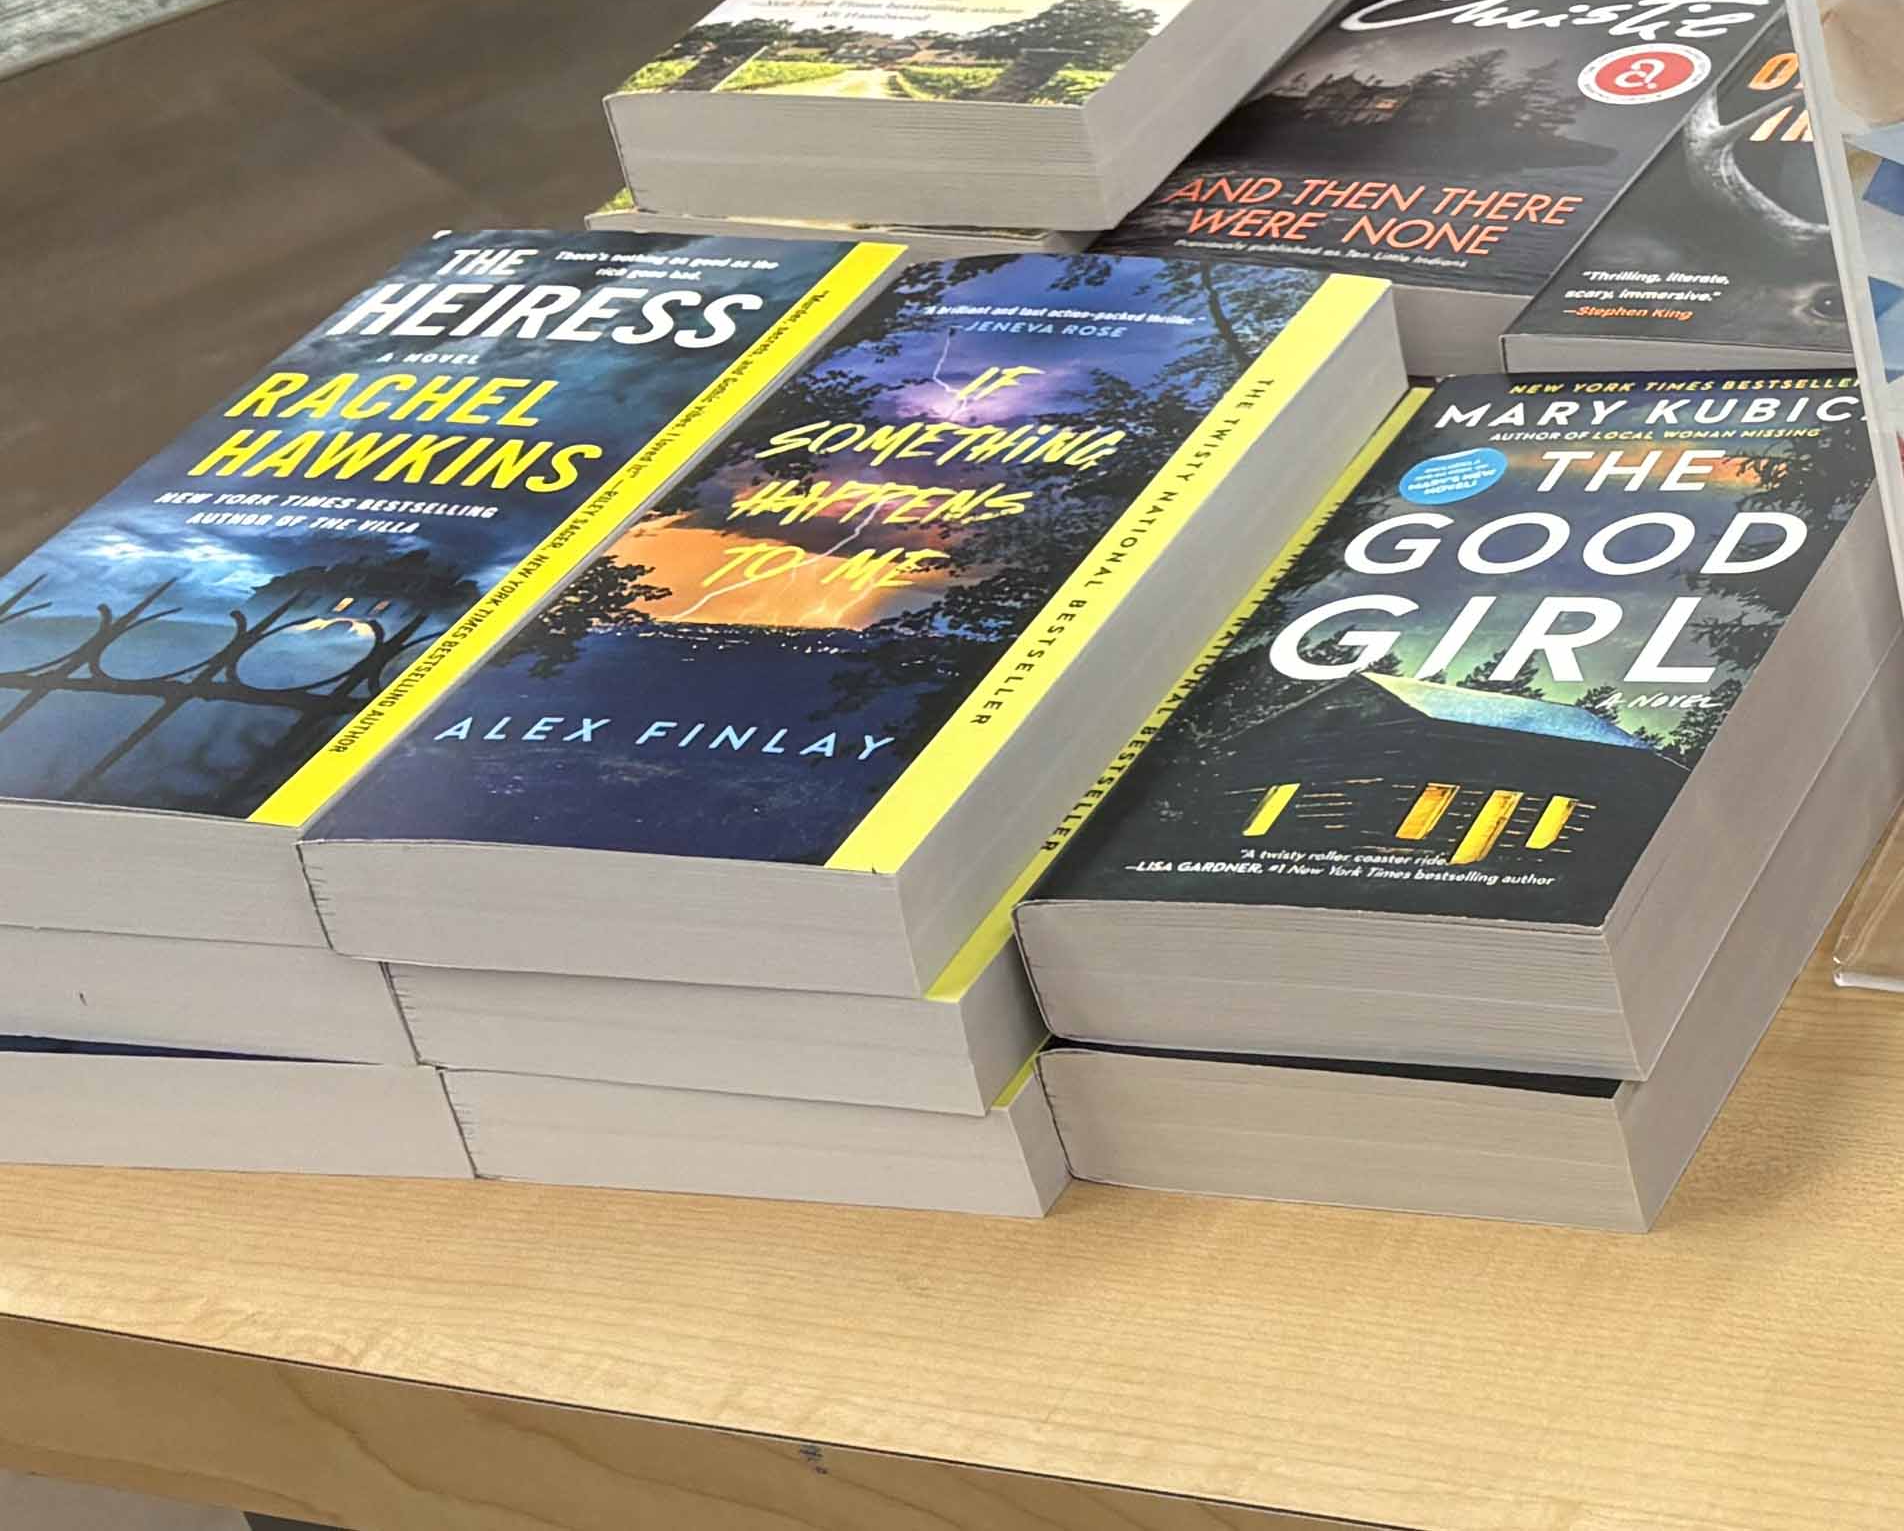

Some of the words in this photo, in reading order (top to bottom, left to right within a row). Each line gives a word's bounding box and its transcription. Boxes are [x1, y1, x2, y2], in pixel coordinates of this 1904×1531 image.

[1162, 177, 1283, 204] AND
[1290, 179, 1426, 212] THEN
[1432, 187, 1584, 226] THERE
[1187, 208, 1327, 240] WERE
[1341, 219, 1509, 255] NONE
[440, 249, 539, 277] THE
[325, 284, 763, 349] HEIRESS
[1062, 326, 1128, 338] ROSE
[1652, 308, 1693, 320] King
[377, 353, 395, 363] A
[404, 353, 481, 365] NOVEL
[224, 373, 559, 428] RACHEL
[957, 367, 1047, 401] IF
[1235, 378, 1275, 410] THE
[1510, 384, 1563, 394] NEW
[1573, 382, 1636, 393] YORK
[1644, 380, 1713, 392] TIMES
[1722, 377, 1861, 391] BESTSELLE
[1435, 400, 1629, 429] MARY
[1646, 395, 1868, 426] KUBIC
[755, 420, 1127, 471] SOMETHING
[1176, 418, 1241, 482] TWISTY
[1489, 430, 1571, 442] AUTHOR
[1573, 430, 1592, 441] OF
[1592, 429, 1655, 441] LOCAL
[1662, 429, 1735, 440] WOMAN
[1738, 427, 1822, 439] MISSING
[187, 430, 603, 493] HAWKINS
[1537, 450, 1727, 493] THE
[153, 491, 213, 504] NEW
[213, 493, 279, 506] YORK
[280, 495, 356, 510] TIMES
[355, 498, 499, 519] BESTSELLING
[727, 481, 1034, 526] HAPPENS
[186, 512, 273, 527] AUTHOR
[275, 515, 307, 528] OF
[309, 517, 356, 531] THE
[357, 519, 420, 534] VILLA
[1084, 491, 1179, 588] NATIONAL
[1343, 512, 1809, 576] GOOD
[518, 554, 550, 578] NEW
[702, 544, 805, 588] TO
[822, 546, 951, 592] ME
[491, 578, 522, 608] YORK
[460, 608, 494, 641] TIMES
[1269, 593, 1718, 684] GIRL
[379, 640, 453, 708] BESTSELLING
[970, 599, 1088, 725] BESTSELLER
[1630, 692, 1724, 711] NOVEL
[329, 707, 386, 754] AUTHOR
[434, 717, 612, 745] ALEX
[636, 720, 896, 762] FINLAY
[1259, 849, 1305, 863] twisty
[1308, 851, 1350, 863] roller
[1353, 854, 1412, 866] coaster
[1288, 863, 1323, 875] New
[1326, 865, 1362, 878] York
[1365, 868, 1412, 880] Times
[1414, 869, 1499, 885] bestselling
[1500, 873, 1557, 886] author
